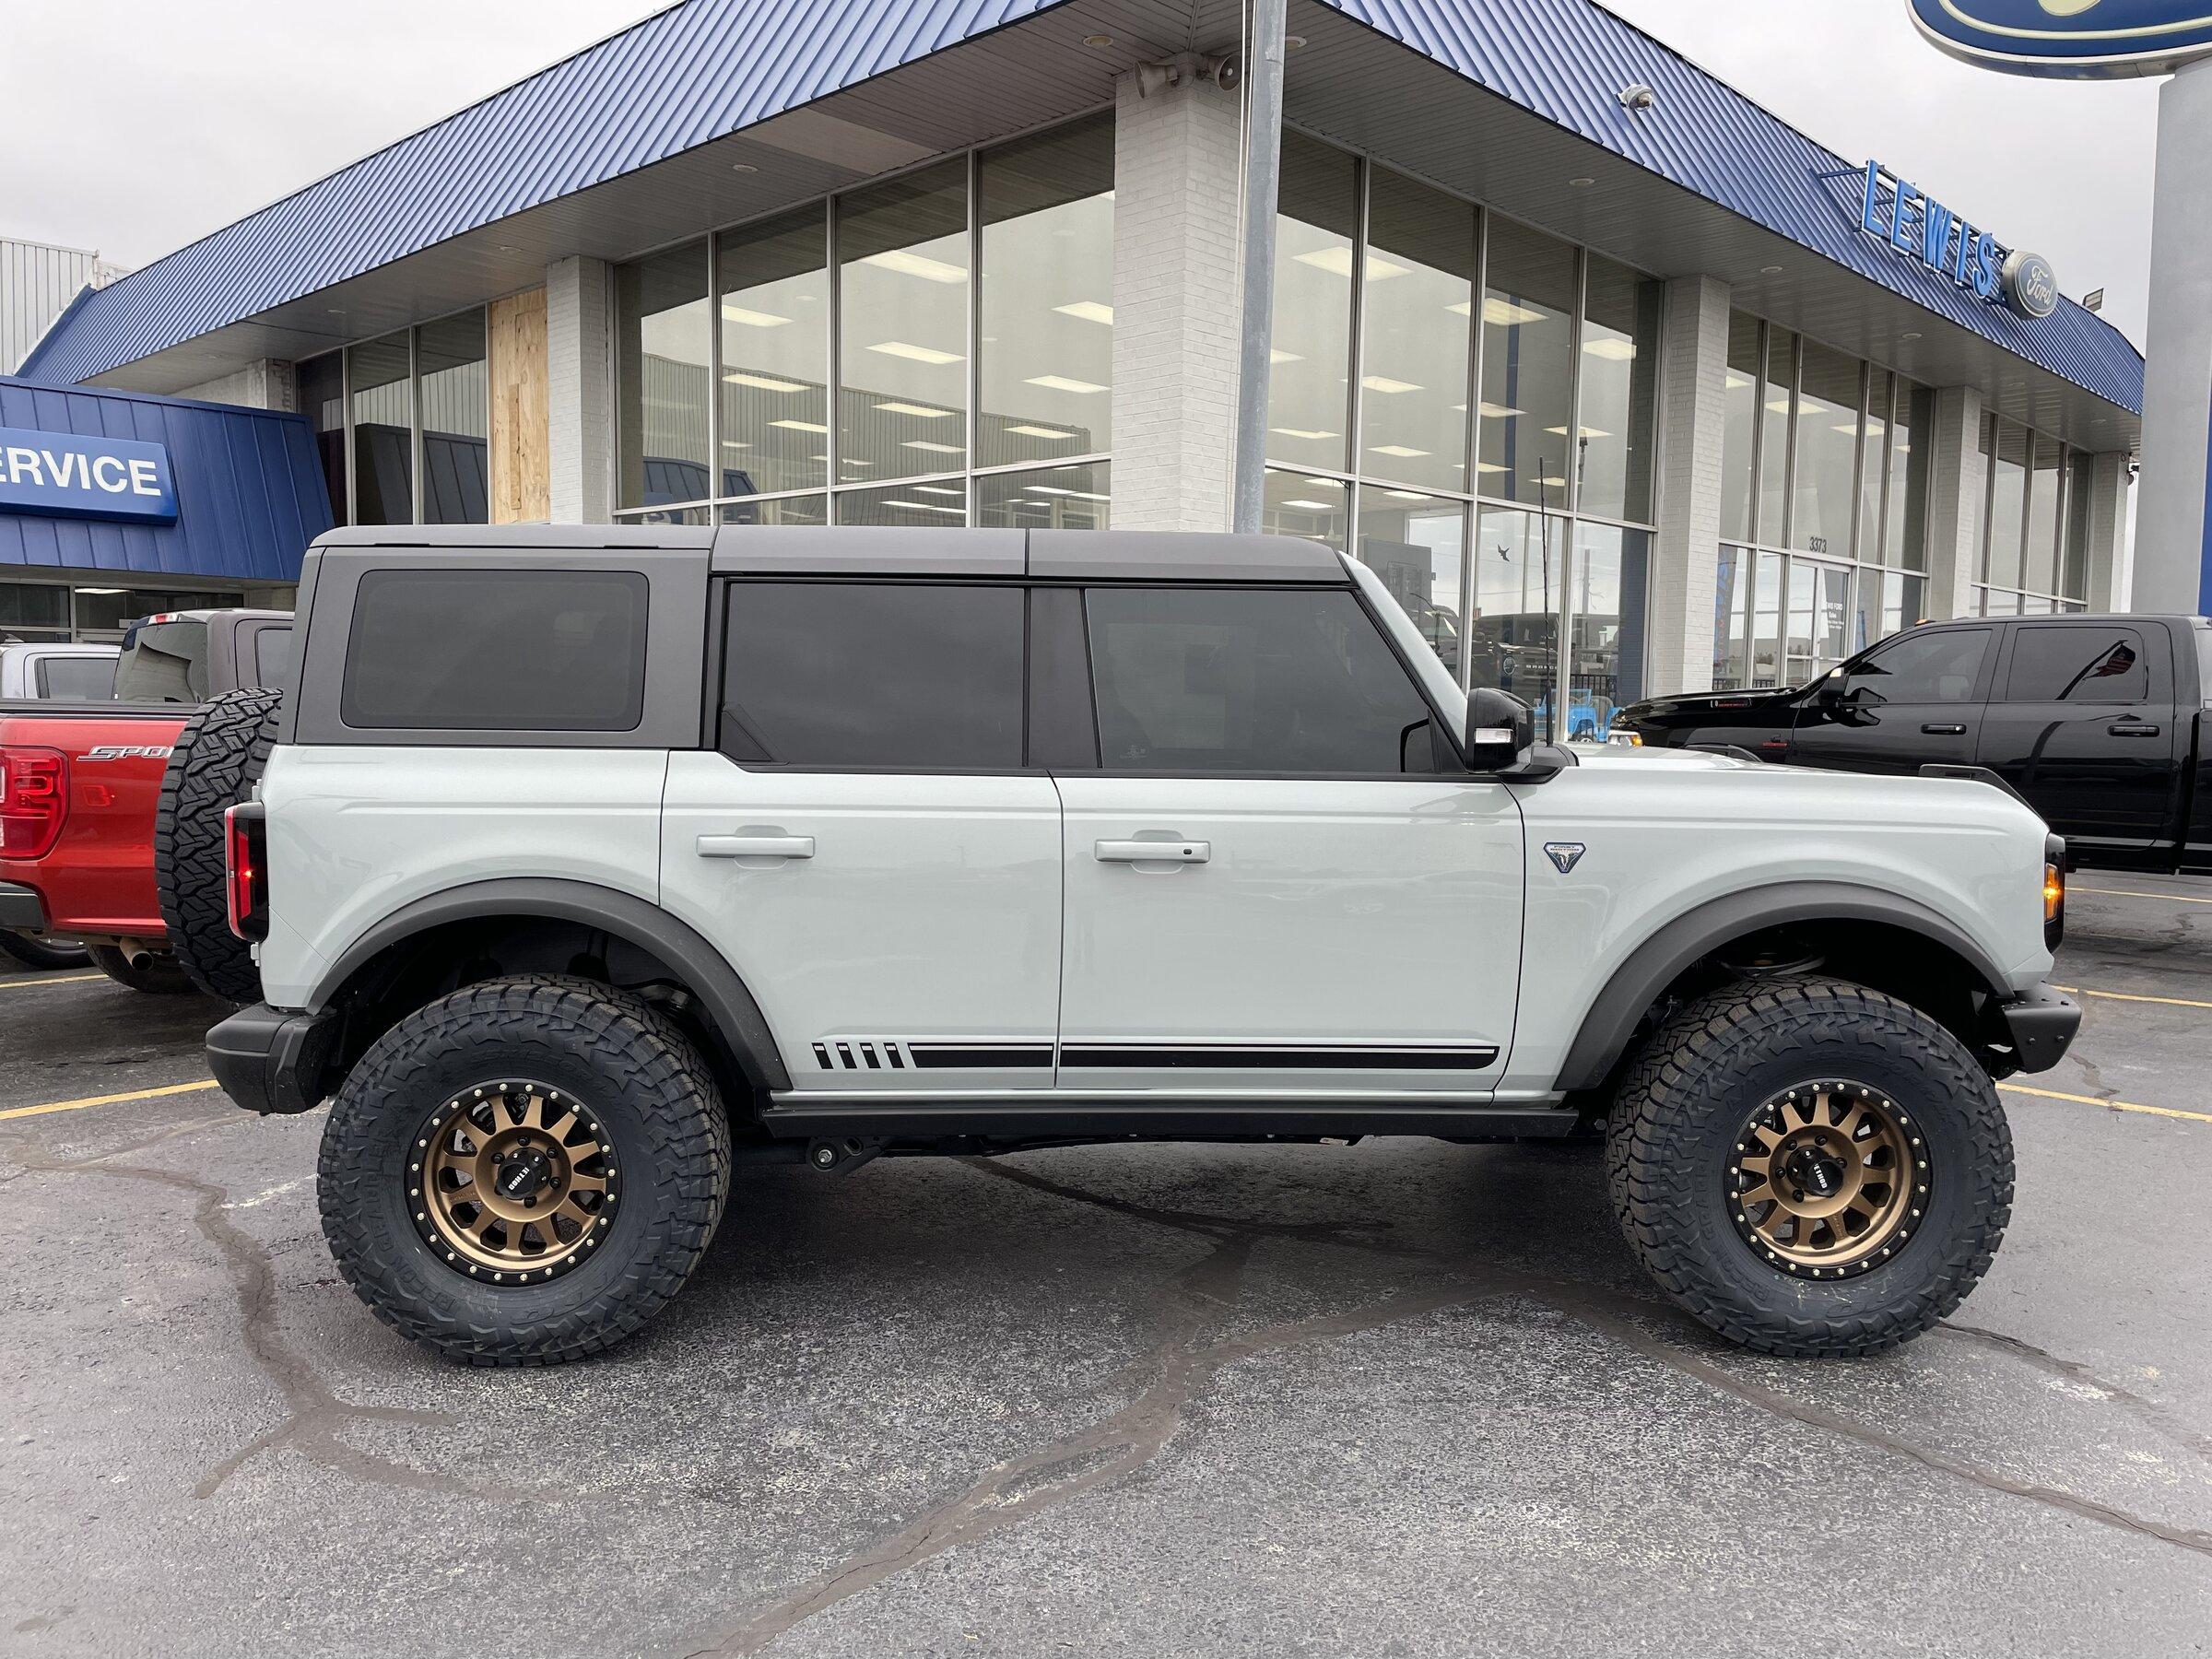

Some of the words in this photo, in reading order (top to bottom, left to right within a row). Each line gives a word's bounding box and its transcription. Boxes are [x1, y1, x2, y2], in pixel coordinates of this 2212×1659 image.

[1861, 157, 1995, 299] LEWIS
[2027, 265, 2053, 305] Ford
[0, 446, 161, 496] RVICE
[1809, 536, 1827, 553] 3373
[1813, 1163, 1828, 1189] ETHOD
